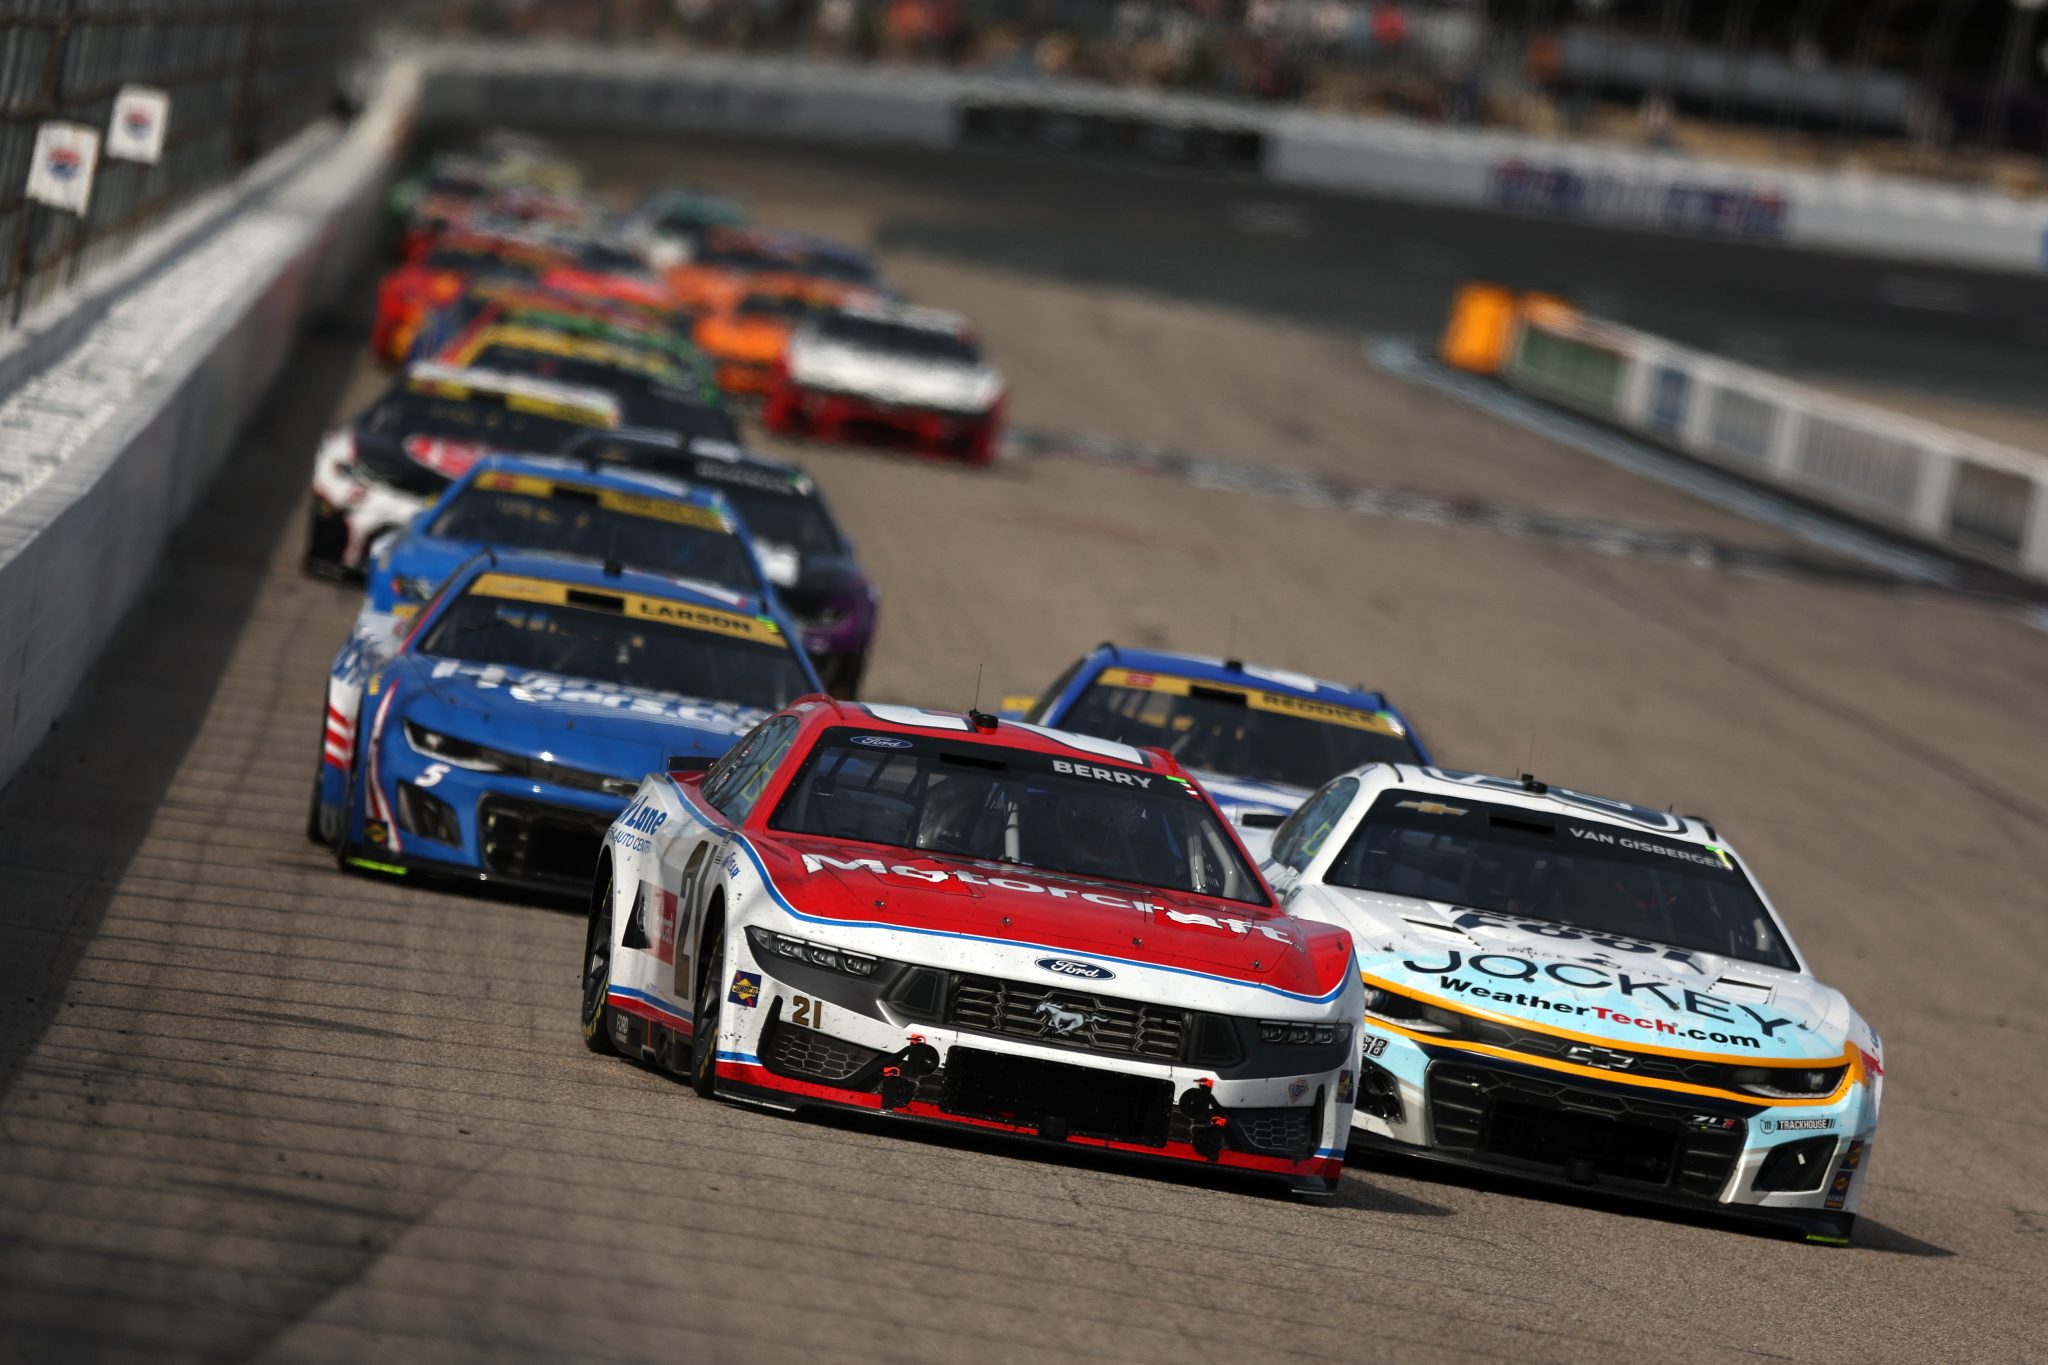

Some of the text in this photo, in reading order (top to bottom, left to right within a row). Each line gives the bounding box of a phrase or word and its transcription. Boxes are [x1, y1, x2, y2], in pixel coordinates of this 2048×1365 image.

[640, 602, 752, 636] LARSON
[1262, 693, 1377, 728] REDDICK
[859, 736, 905, 749] Ford
[413, 763, 453, 788] 5
[1052, 759, 1152, 790] BERRY
[625, 796, 668, 836] Lane
[613, 830, 634, 848] AUTO
[1568, 826, 1616, 846] VAN
[800, 852, 1294, 945] Motorcraft
[1050, 958, 1102, 979] Ford
[1402, 949, 1793, 1039] JOCKEY
[792, 995, 823, 1030] 21
[1439, 975, 1761, 1050] WeatherTech.com
[1778, 1119, 1828, 1131] TRACKHOUSE
